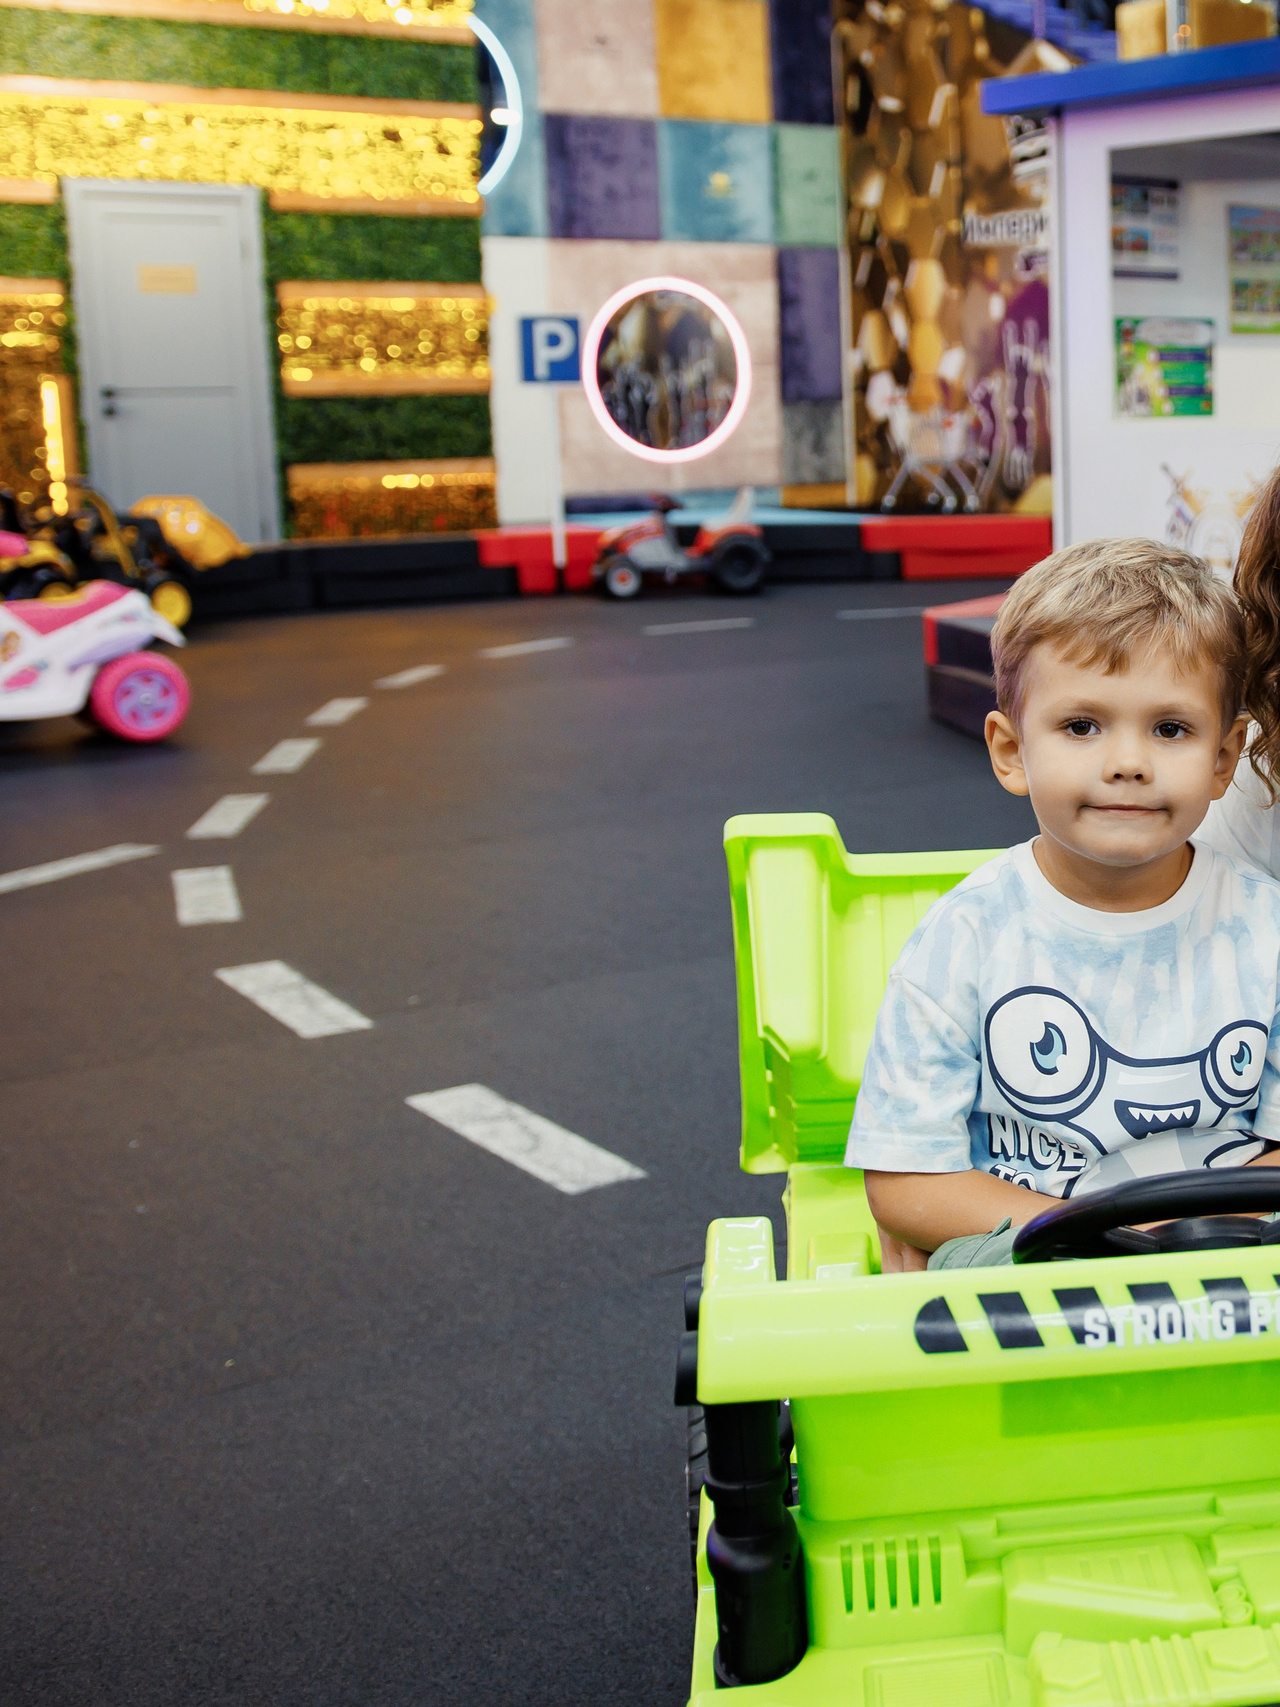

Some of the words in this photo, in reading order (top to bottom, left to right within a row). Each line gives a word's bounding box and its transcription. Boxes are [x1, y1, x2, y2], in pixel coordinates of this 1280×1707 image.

[531, 319, 577, 380] P
[987, 1113, 1087, 1171] NICE
[1083, 1300, 1236, 1349] STRONG
